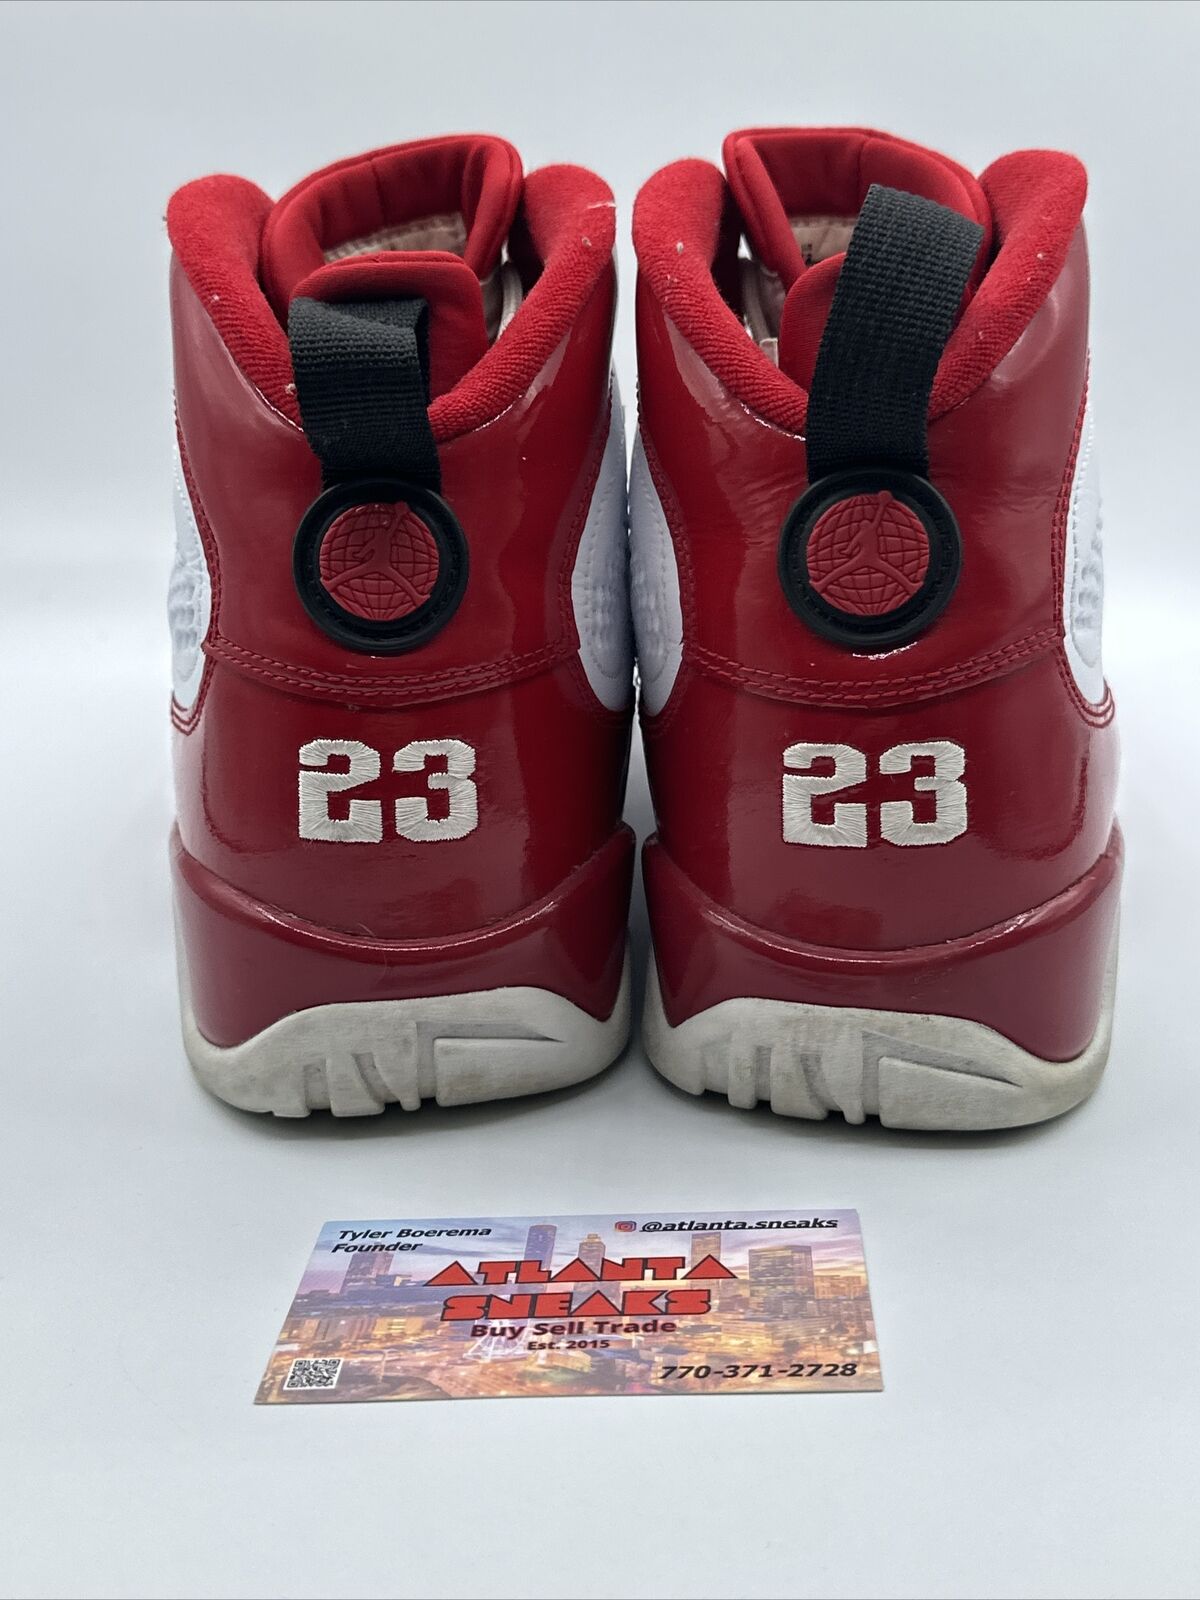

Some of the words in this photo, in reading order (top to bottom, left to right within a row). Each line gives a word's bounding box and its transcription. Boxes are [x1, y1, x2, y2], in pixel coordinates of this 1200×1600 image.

[298, 739, 478, 844] 23
[782, 740, 968, 848] 23
[338, 1230, 393, 1241] Tyler
[396, 1226, 492, 1238] Boerema
[639, 1217, 838, 1232] @atlanta.sneaks
[331, 1240, 423, 1253] Founder
[422, 1253, 738, 1287] ATLANTA
[440, 1288, 712, 1322] SNEAKS
[470, 1323, 527, 1339] Buy
[531, 1321, 590, 1336] Sell
[593, 1319, 677, 1334] Trade
[527, 1340, 561, 1351] Est.
[565, 1339, 610, 1350] 2015
[659, 1362, 857, 1379] 770-371-2728
